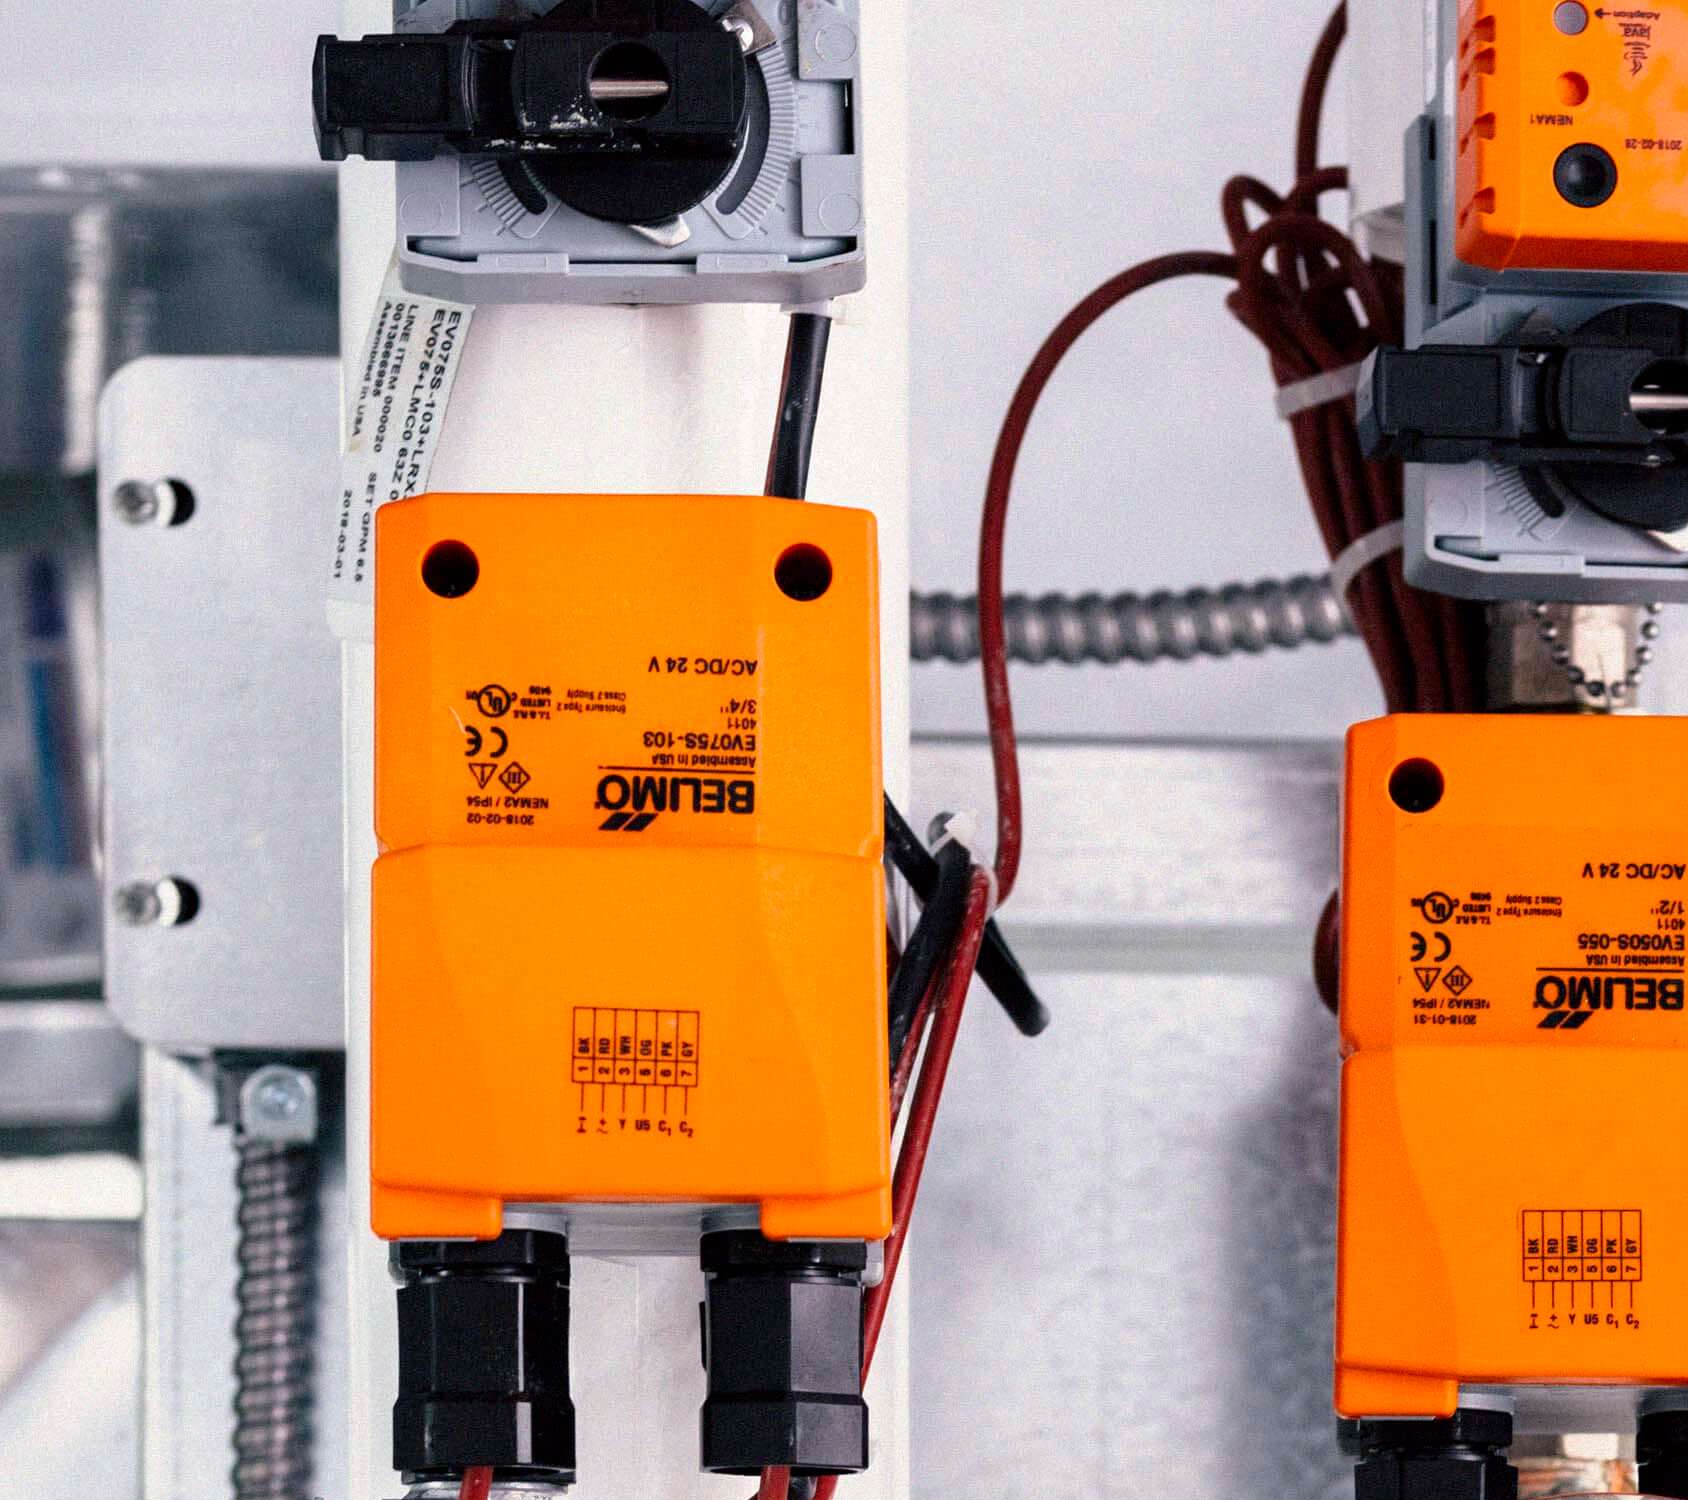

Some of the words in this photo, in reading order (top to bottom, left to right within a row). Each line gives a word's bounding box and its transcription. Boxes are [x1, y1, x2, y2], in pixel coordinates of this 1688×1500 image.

[1529, 114, 1573, 126] NEMA1
[1625, 138, 1682, 151] 2018-02-28
[399, 303, 420, 343] LINE
[362, 300, 393, 382] Assembled
[386, 346, 408, 392] ITEM
[400, 310, 462, 503] EV075S-103+LRX
[351, 403, 367, 438] USA
[372, 394, 395, 454] 000020
[364, 471, 378, 507] SET
[331, 489, 353, 581] 2018-03-01
[355, 511, 371, 554] GPM
[648, 657, 659, 672] V
[667, 657, 687, 674] 24
[695, 658, 757, 675] AC/DC
[727, 718, 757, 729] 4011
[643, 731, 756, 751] EV075S-103
[652, 754, 674, 765] USA
[691, 755, 756, 767] Assembled
[596, 774, 755, 814] BELIMO
[467, 796, 493, 808] IP54
[496, 797, 500, 808] /
[505, 797, 549, 809] NEMA2
[467, 813, 534, 825] 2018-02-02
[1582, 863, 1593, 878] V
[1600, 863, 1620, 879] 24
[1626, 864, 1685, 879] AC/DC
[1657, 918, 1686, 930] 4011
[1578, 934, 1685, 950] EV050S-055
[1586, 955, 1607, 966] USA
[1623, 955, 1685, 966] Assembled
[1535, 976, 1684, 1010] BELIMO
[1413, 998, 1437, 1008] IP54
[1440, 998, 1444, 1008] /
[1448, 998, 1490, 1008] NEMA2
[1413, 1014, 1477, 1025] 2018-01-31
